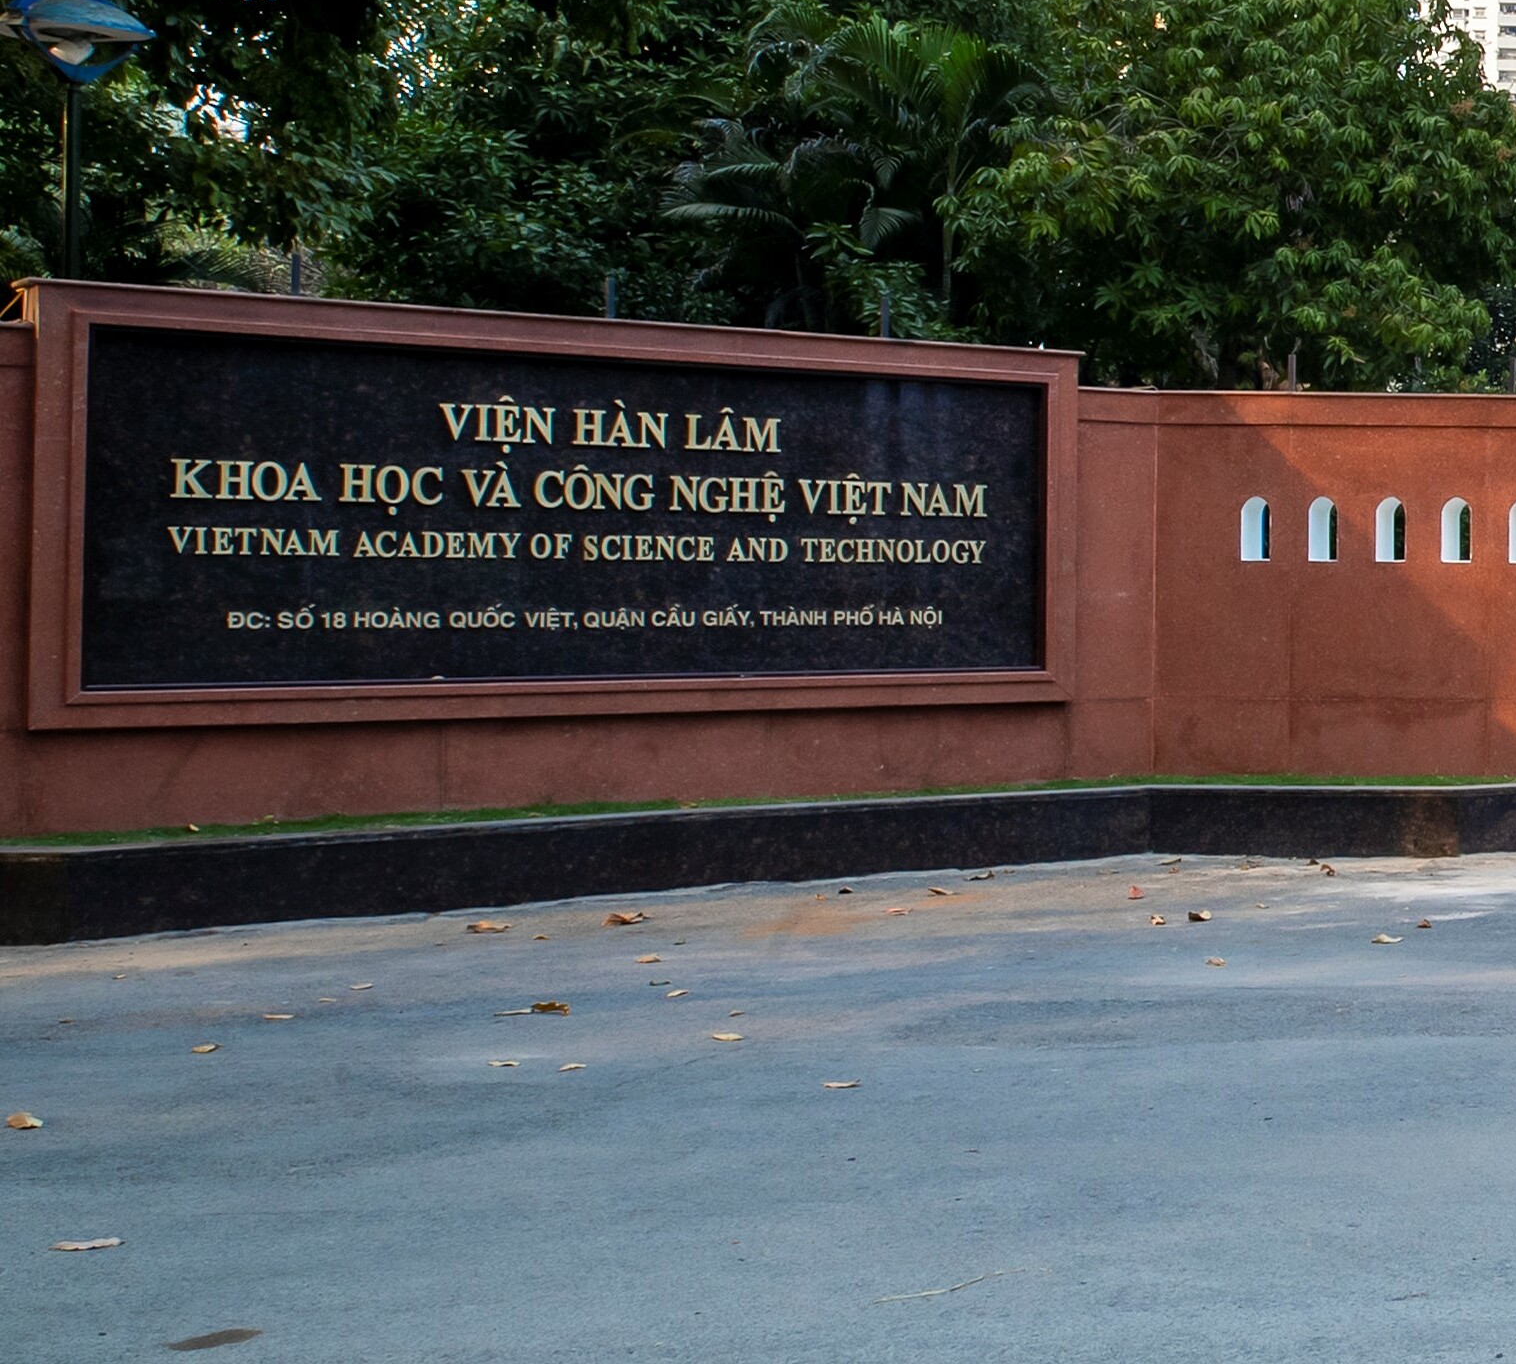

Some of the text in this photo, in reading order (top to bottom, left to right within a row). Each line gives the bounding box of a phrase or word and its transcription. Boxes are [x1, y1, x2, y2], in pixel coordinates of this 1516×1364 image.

[440, 395, 782, 454] VIỆN HÀN LÂM
[170, 458, 988, 524] KHOA HỌC VÀ CÔNG NGHỆ VIỆT NAM
[167, 526, 987, 564] VIETNAM ACADEMY OF SCIENCE AND TECHNOLOGY
[226, 604, 943, 631] ĐC: SỐ 18 HOÀNG QUỐC VIỆT, QUẬN CẦU GIẤY, THÀNH PHỐ HÀ NỘI
